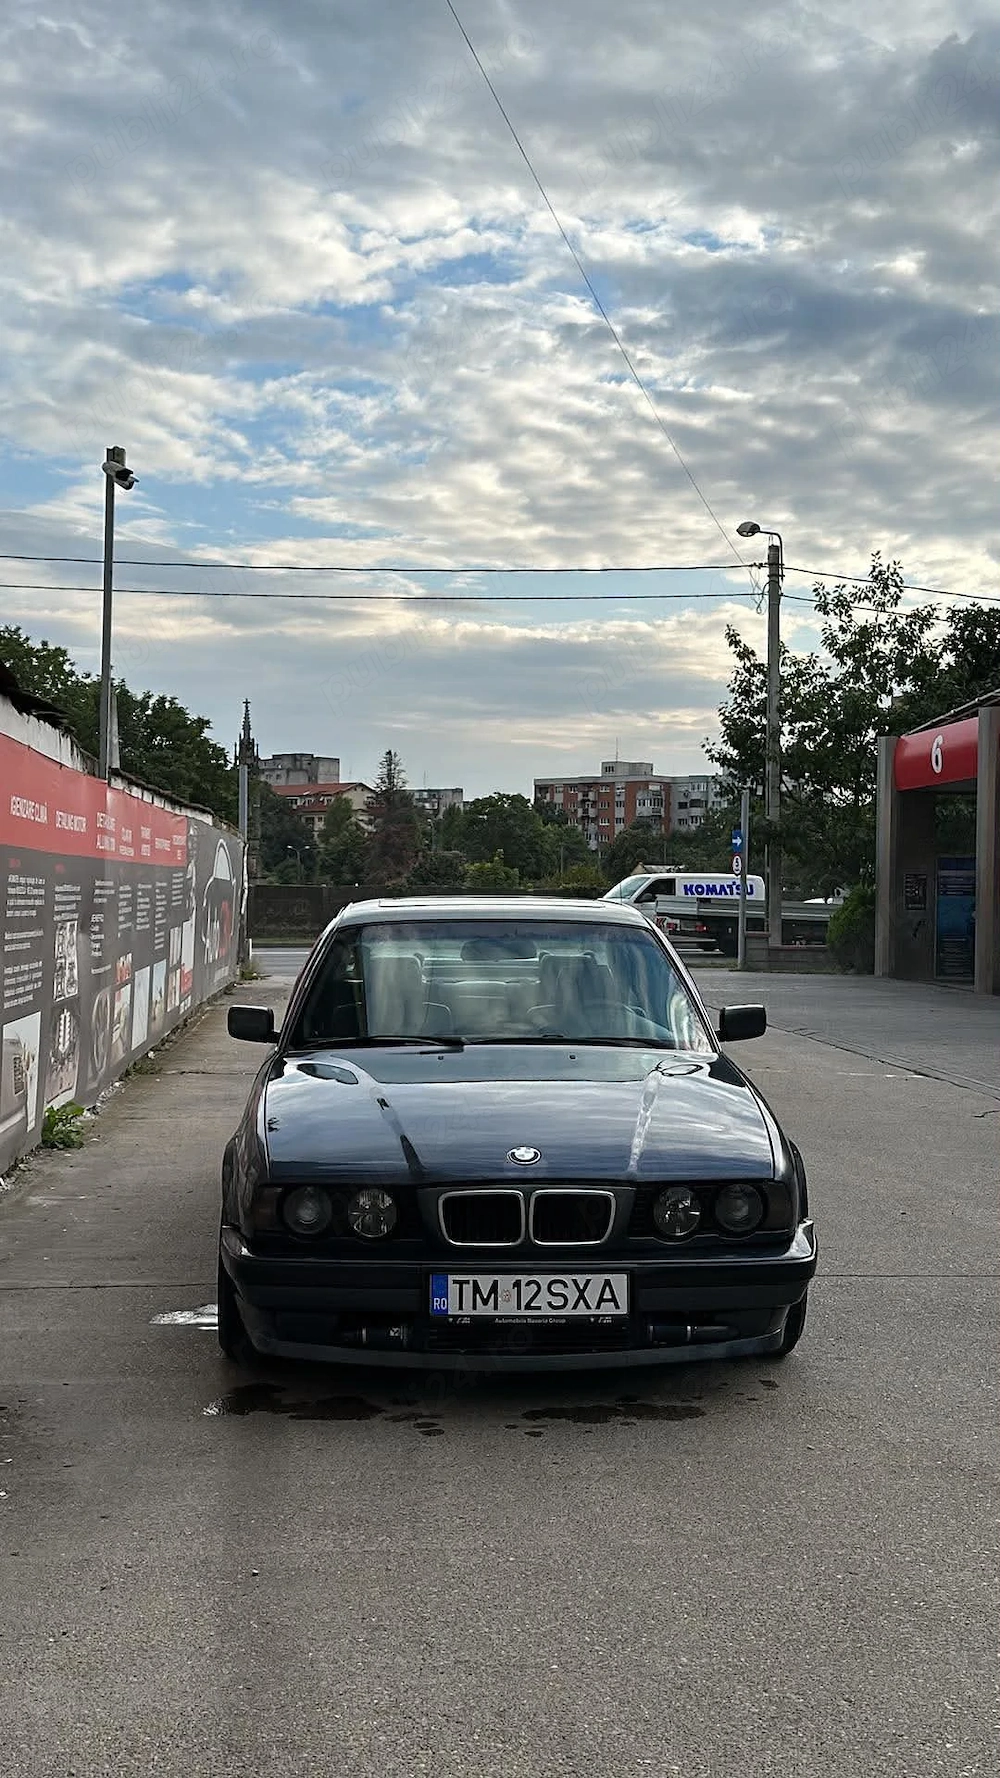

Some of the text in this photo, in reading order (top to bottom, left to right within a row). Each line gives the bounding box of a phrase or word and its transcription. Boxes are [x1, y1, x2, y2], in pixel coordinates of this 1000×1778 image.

[930, 734, 944, 774] 6
[683, 881, 754, 896] KOMATSU
[433, 1298, 447, 1310] RO
[452, 1279, 499, 1311] TM
